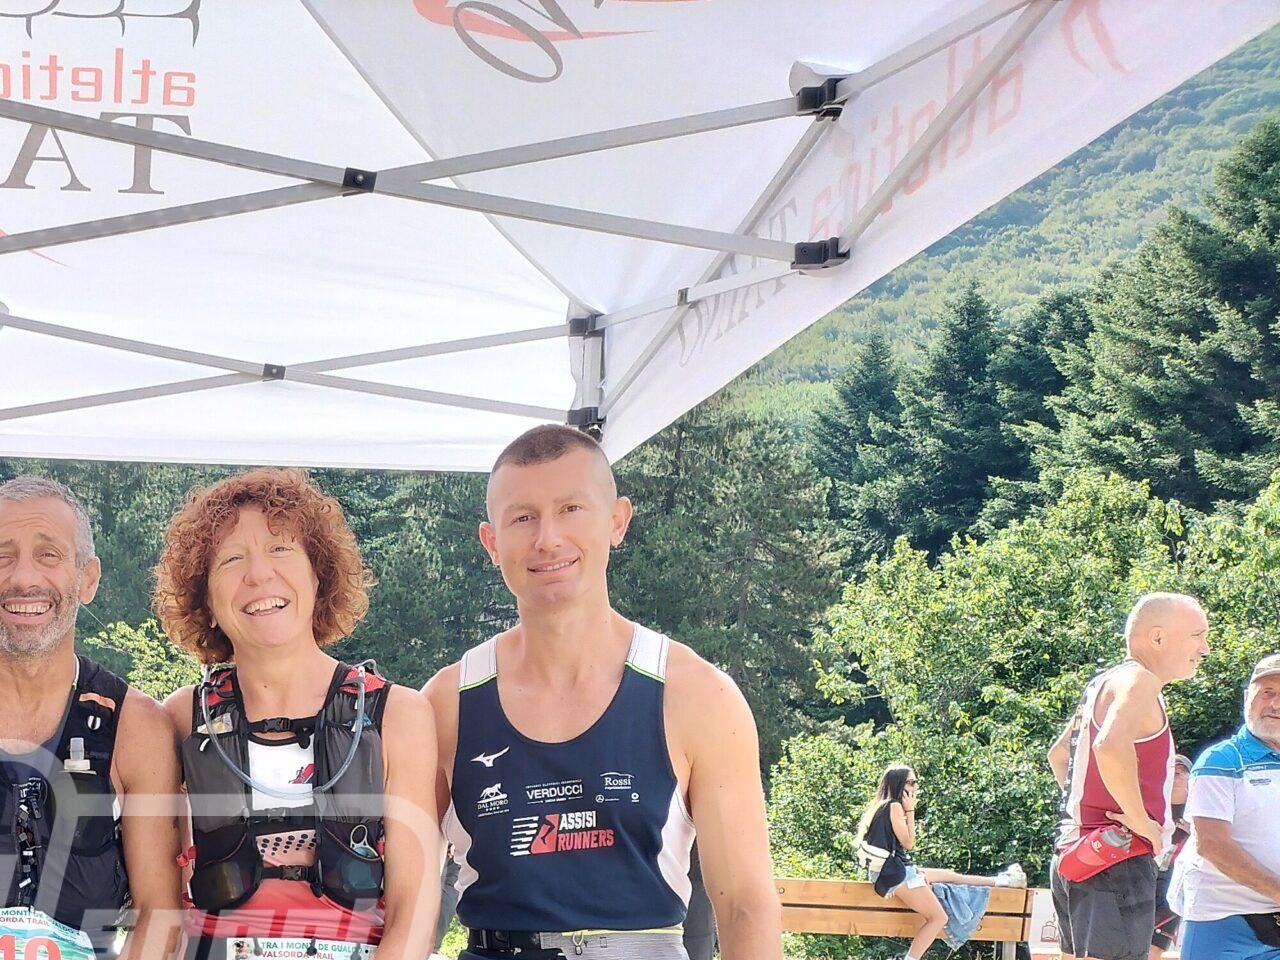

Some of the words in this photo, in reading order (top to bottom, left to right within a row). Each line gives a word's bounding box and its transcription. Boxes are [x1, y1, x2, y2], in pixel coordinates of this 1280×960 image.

[604, 776, 632, 786] Rossi
[526, 784, 583, 800] VERDUCCI
[477, 802, 490, 810] DAL
[490, 799, 509, 808] MORO
[559, 811, 596, 831] ASSISI
[558, 829, 614, 851] RUNNERS
[27, 918, 50, 927] TRAIL
[262, 950, 310, 959] VALSORDA
